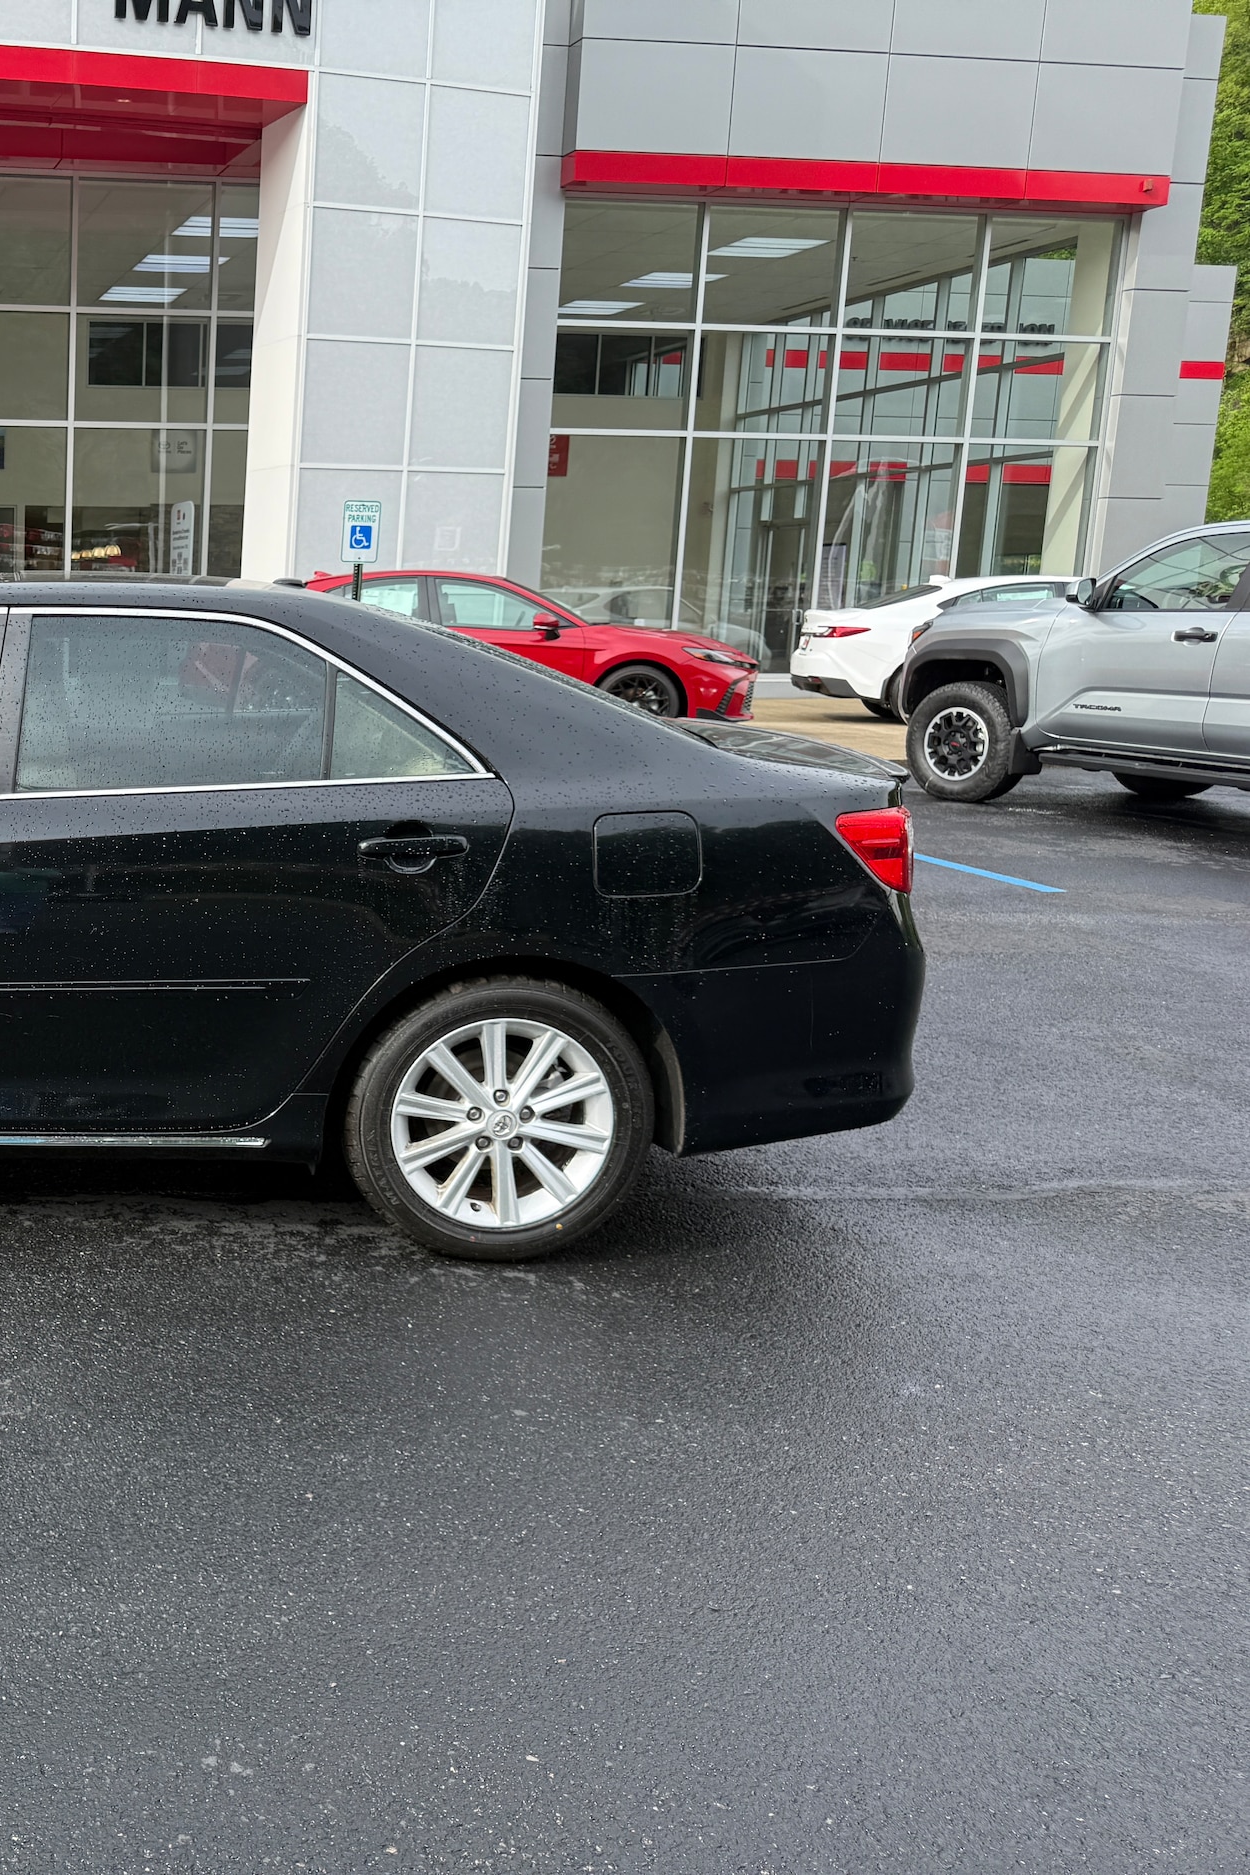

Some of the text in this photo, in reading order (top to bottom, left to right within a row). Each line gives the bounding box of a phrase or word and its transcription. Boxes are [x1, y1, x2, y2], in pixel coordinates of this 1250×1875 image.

[345, 503, 380, 513] RESERVED
[347, 514, 377, 523] PARKING
[1072, 703, 1122, 712] TACOMA
[365, 1128, 402, 1206] MATRIX
